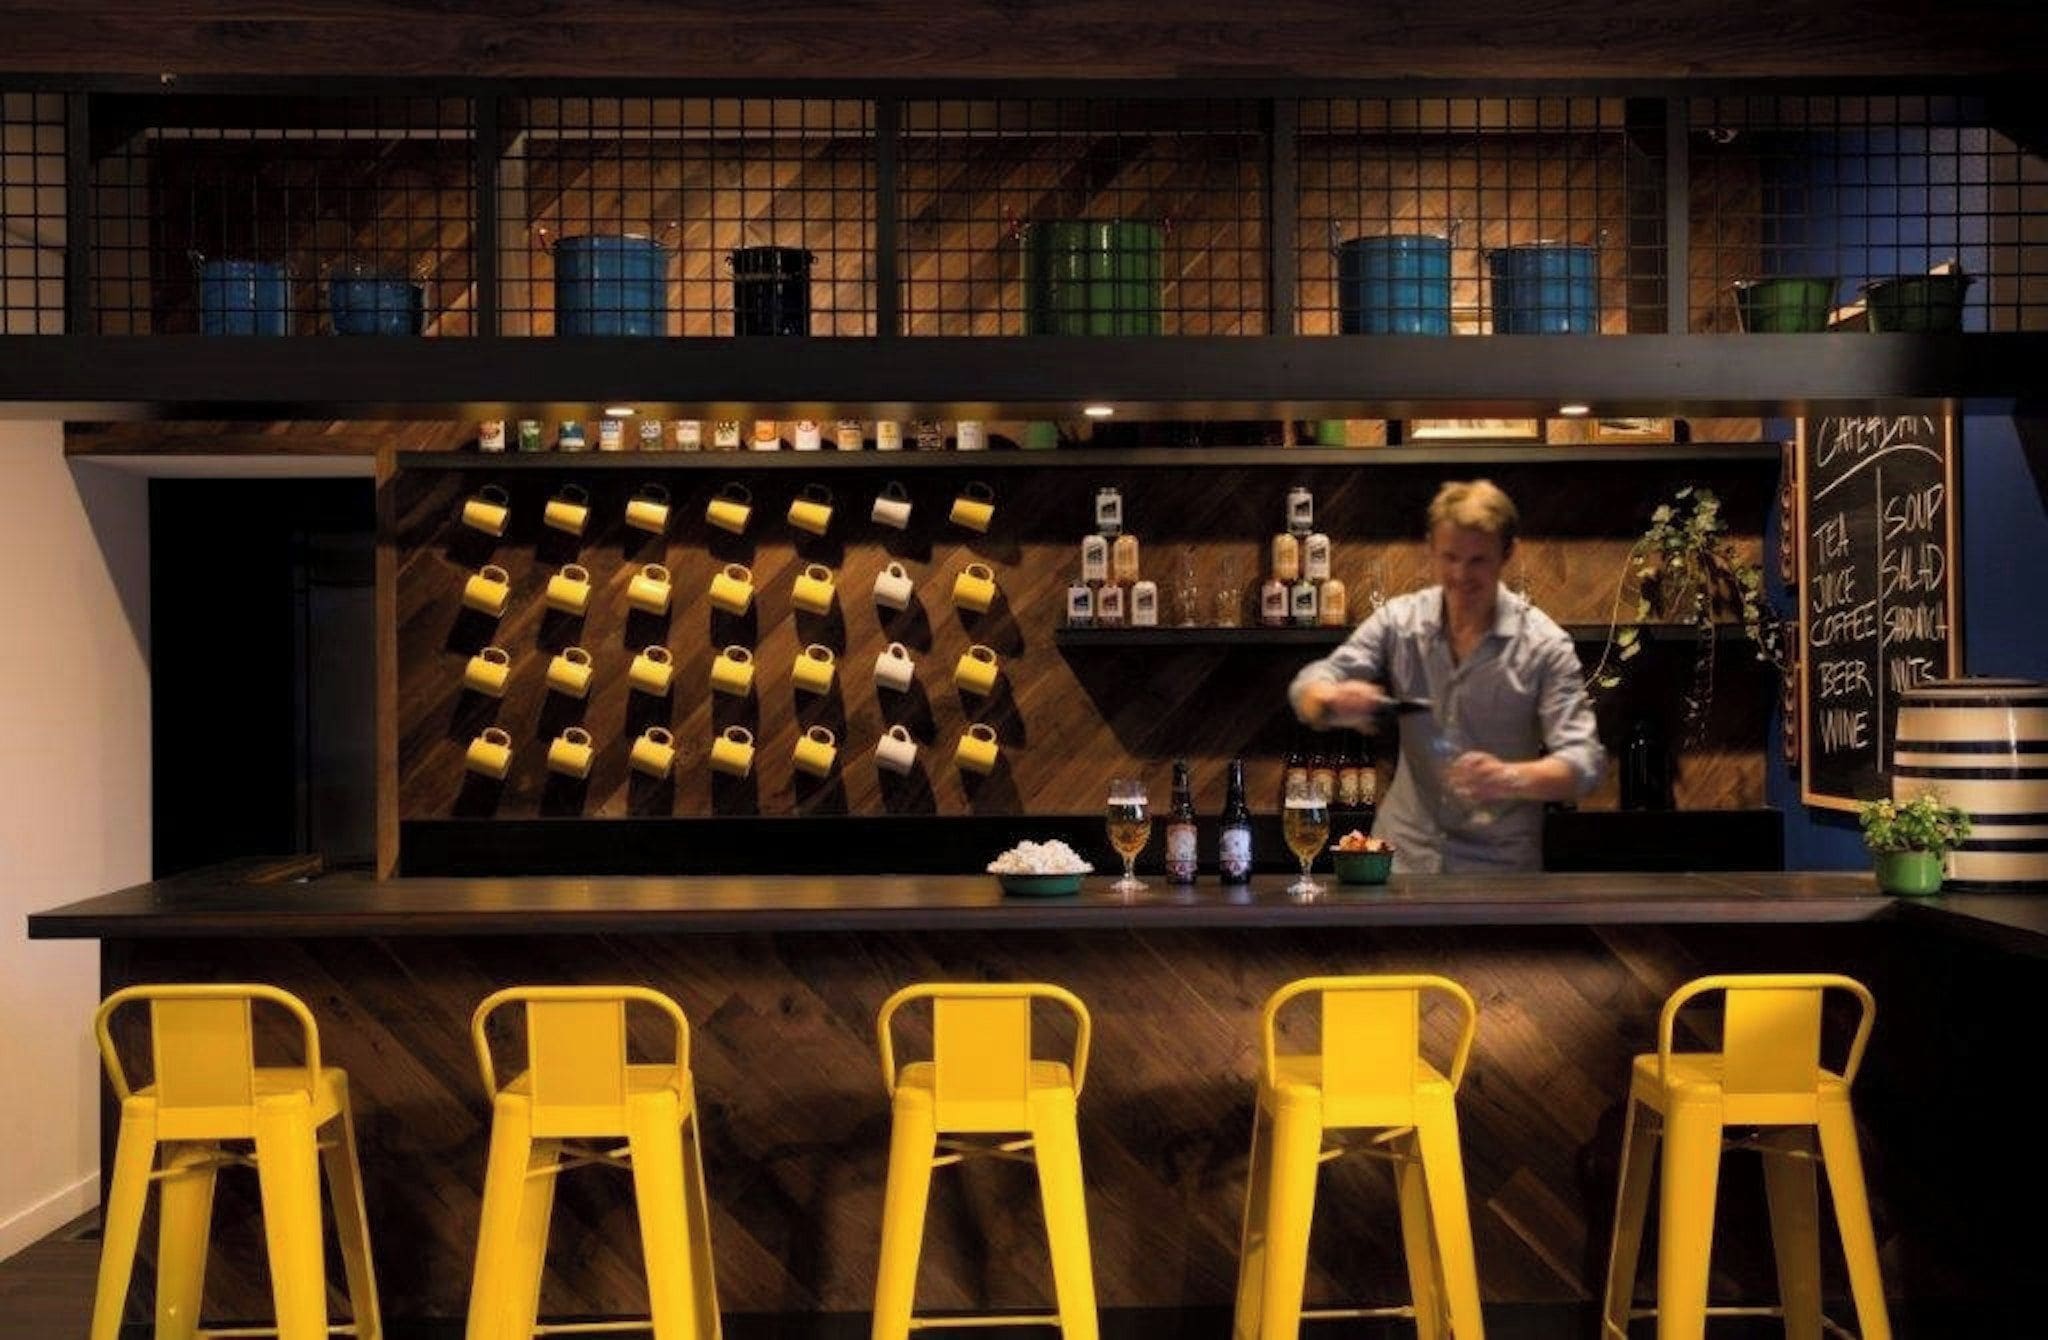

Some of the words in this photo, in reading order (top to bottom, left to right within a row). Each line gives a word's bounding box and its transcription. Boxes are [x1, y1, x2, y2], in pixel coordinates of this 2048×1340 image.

[1882, 482, 1945, 541] SOUP
[1812, 510, 1850, 564] TEA
[1812, 564, 1856, 613] JUICE
[1879, 542, 1945, 601] SALAD
[1809, 599, 1877, 648] COFFEE
[1818, 659, 1874, 698] BEER
[1890, 655, 1935, 694] NUTS
[1819, 709, 1869, 754] WINE
